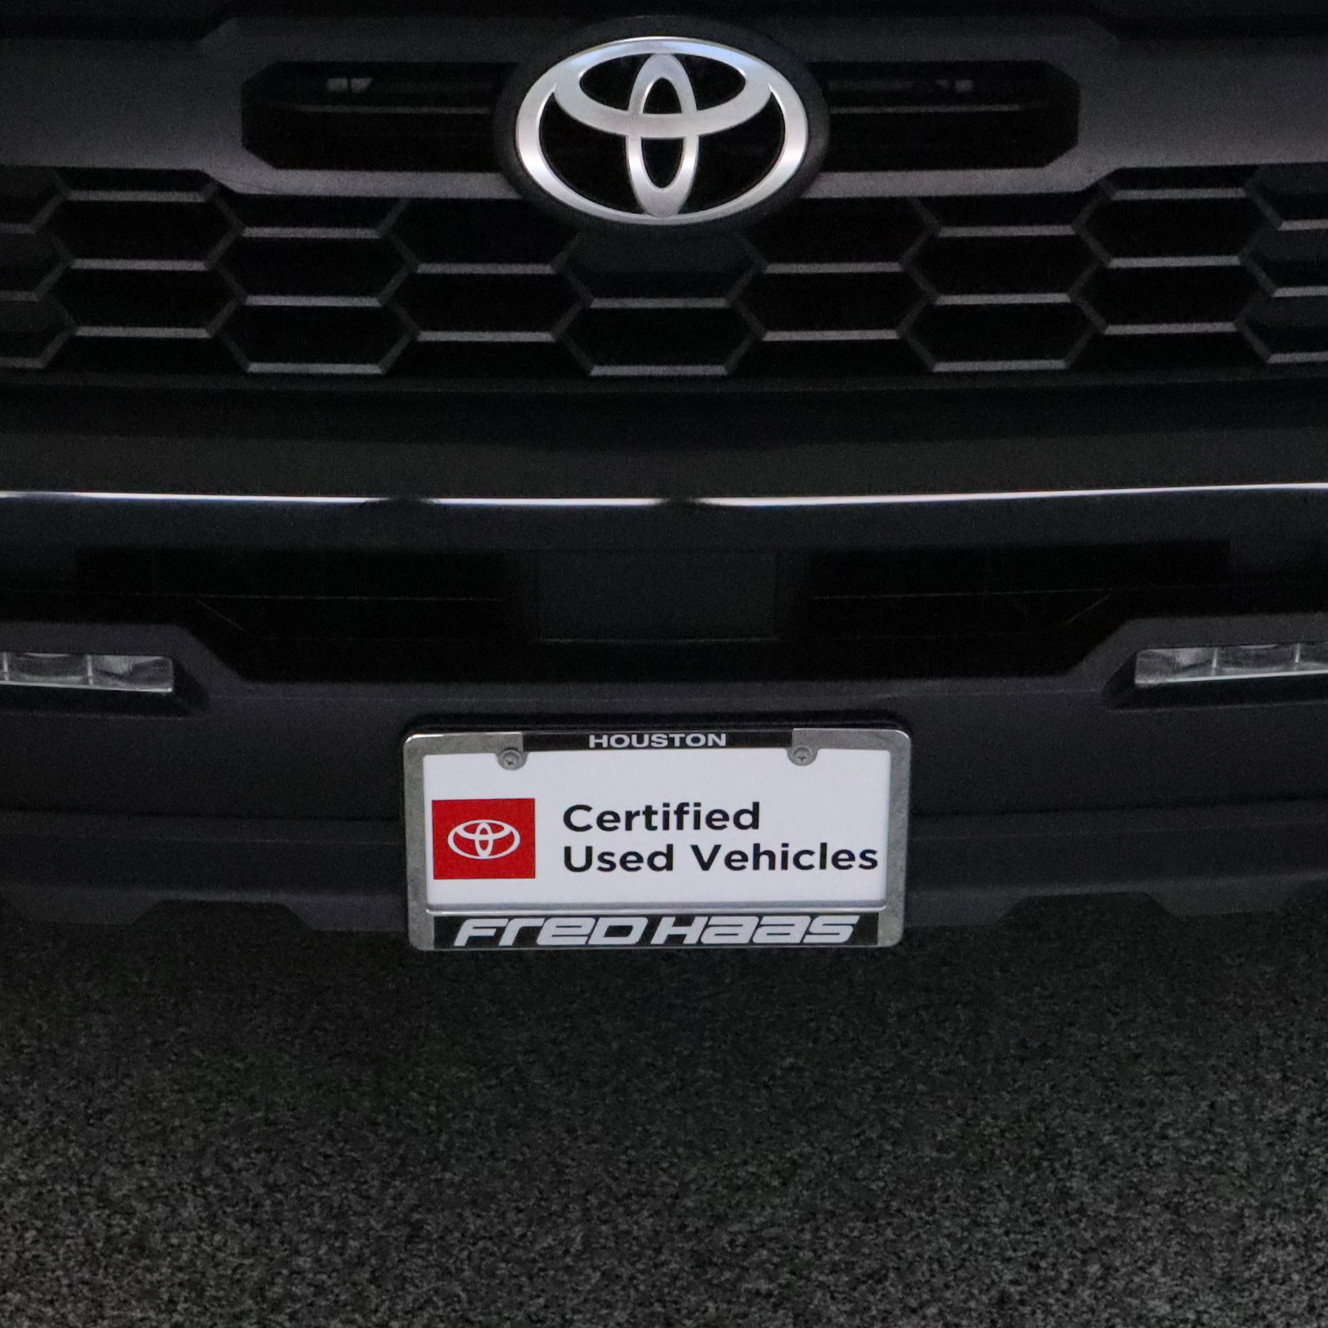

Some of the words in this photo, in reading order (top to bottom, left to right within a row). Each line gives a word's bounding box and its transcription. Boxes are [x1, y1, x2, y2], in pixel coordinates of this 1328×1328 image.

[589, 733, 727, 749] HOUSTON
[563, 802, 761, 833] Certified
[564, 844, 674, 873] Used
[690, 843, 879, 872] Vehicles
